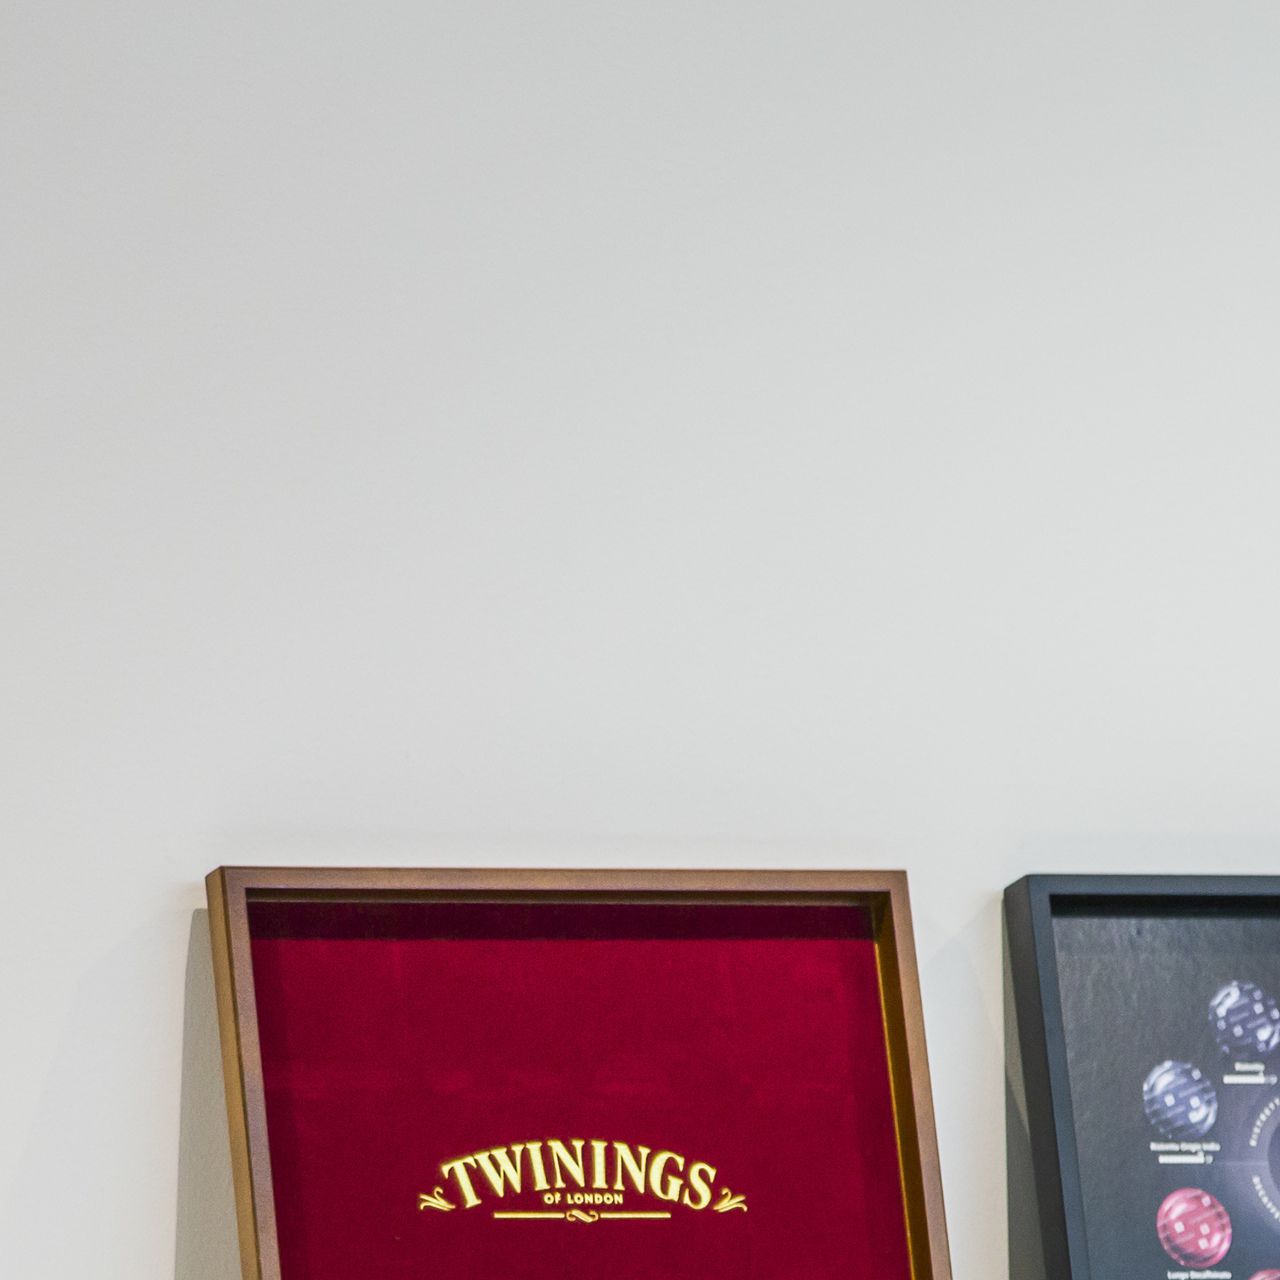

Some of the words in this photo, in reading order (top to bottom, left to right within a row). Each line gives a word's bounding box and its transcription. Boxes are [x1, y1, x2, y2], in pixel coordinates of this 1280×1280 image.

[442, 1139, 717, 1210] TWININGS
[544, 1192, 562, 1205] OF
[567, 1192, 624, 1205] LONDON
